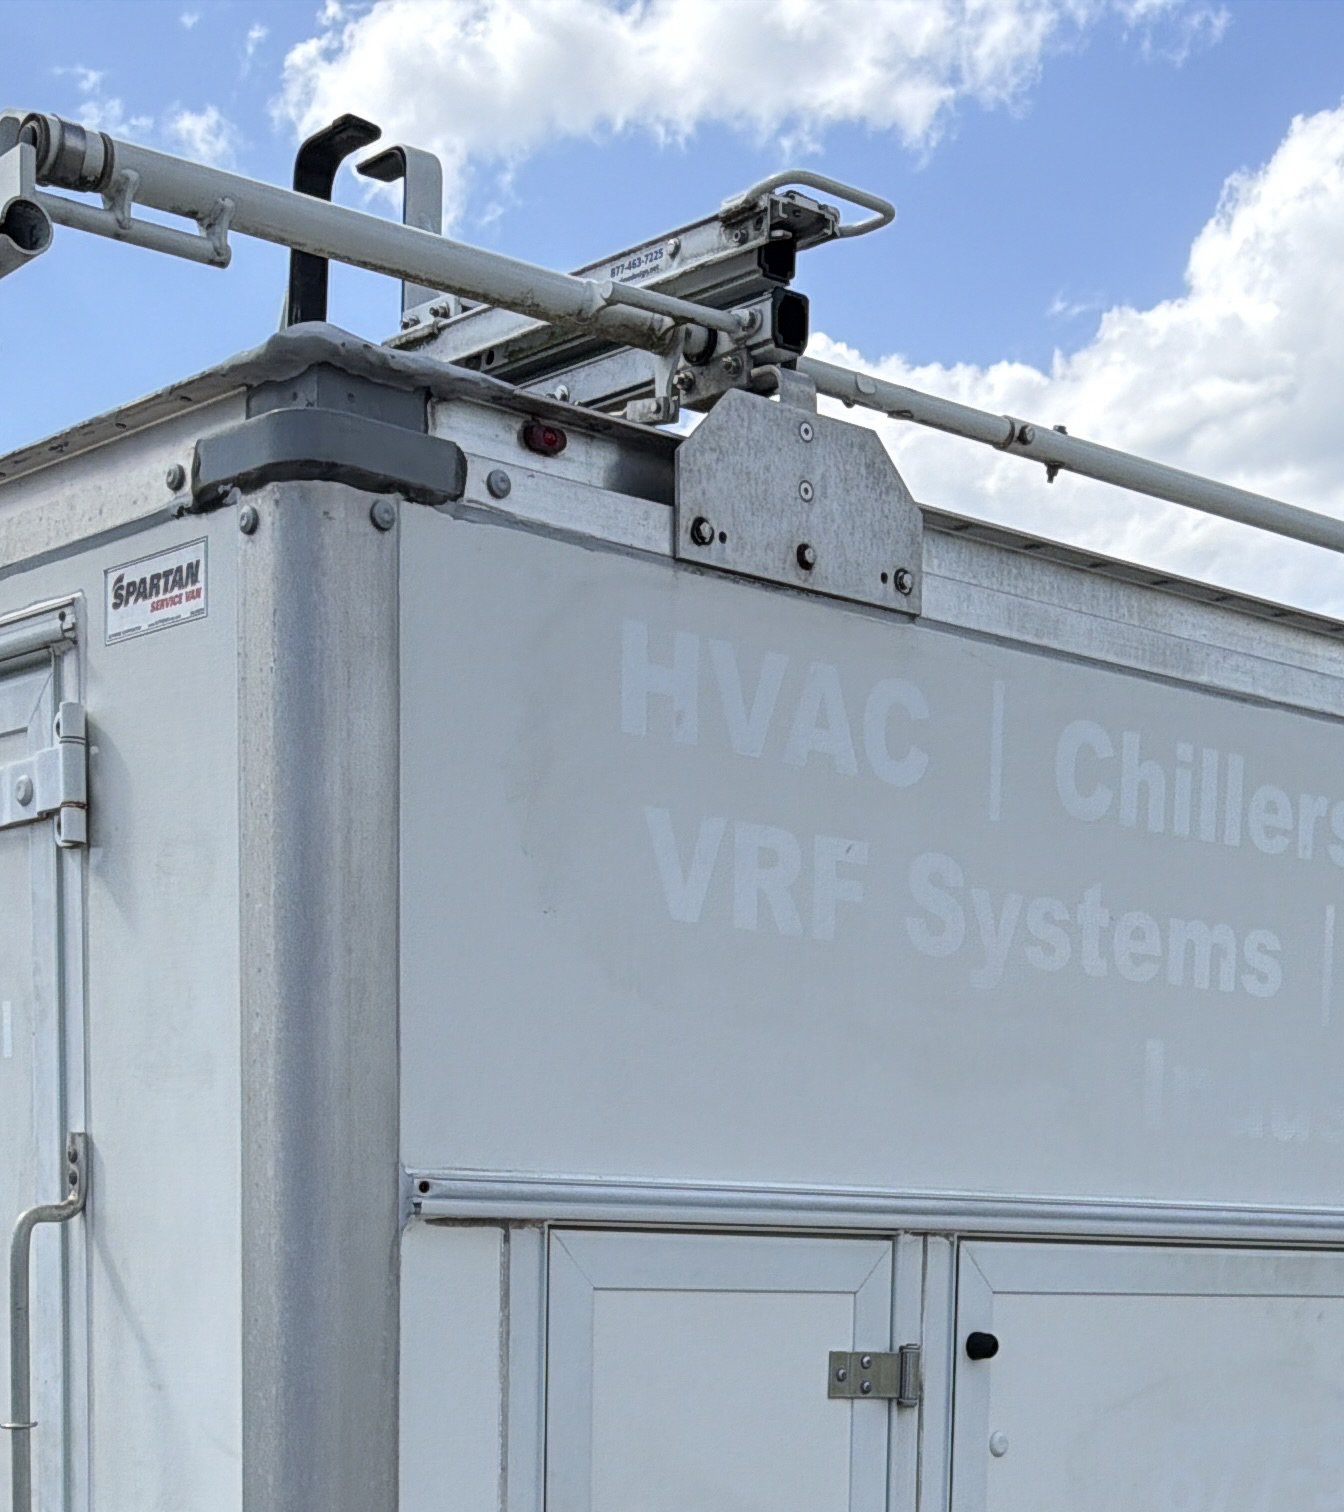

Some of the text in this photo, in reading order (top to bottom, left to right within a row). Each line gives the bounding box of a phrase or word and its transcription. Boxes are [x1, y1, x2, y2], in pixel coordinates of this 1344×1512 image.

[610, 248, 664, 278] 877-463-7225
[112, 559, 200, 610] SPARTAN
[150, 592, 183, 614] SERVICE
[185, 587, 202, 603] VAN
[620, 618, 930, 788] HVAC
[645, 805, 869, 941] VRF
[906, 852, 1283, 998] Systems
